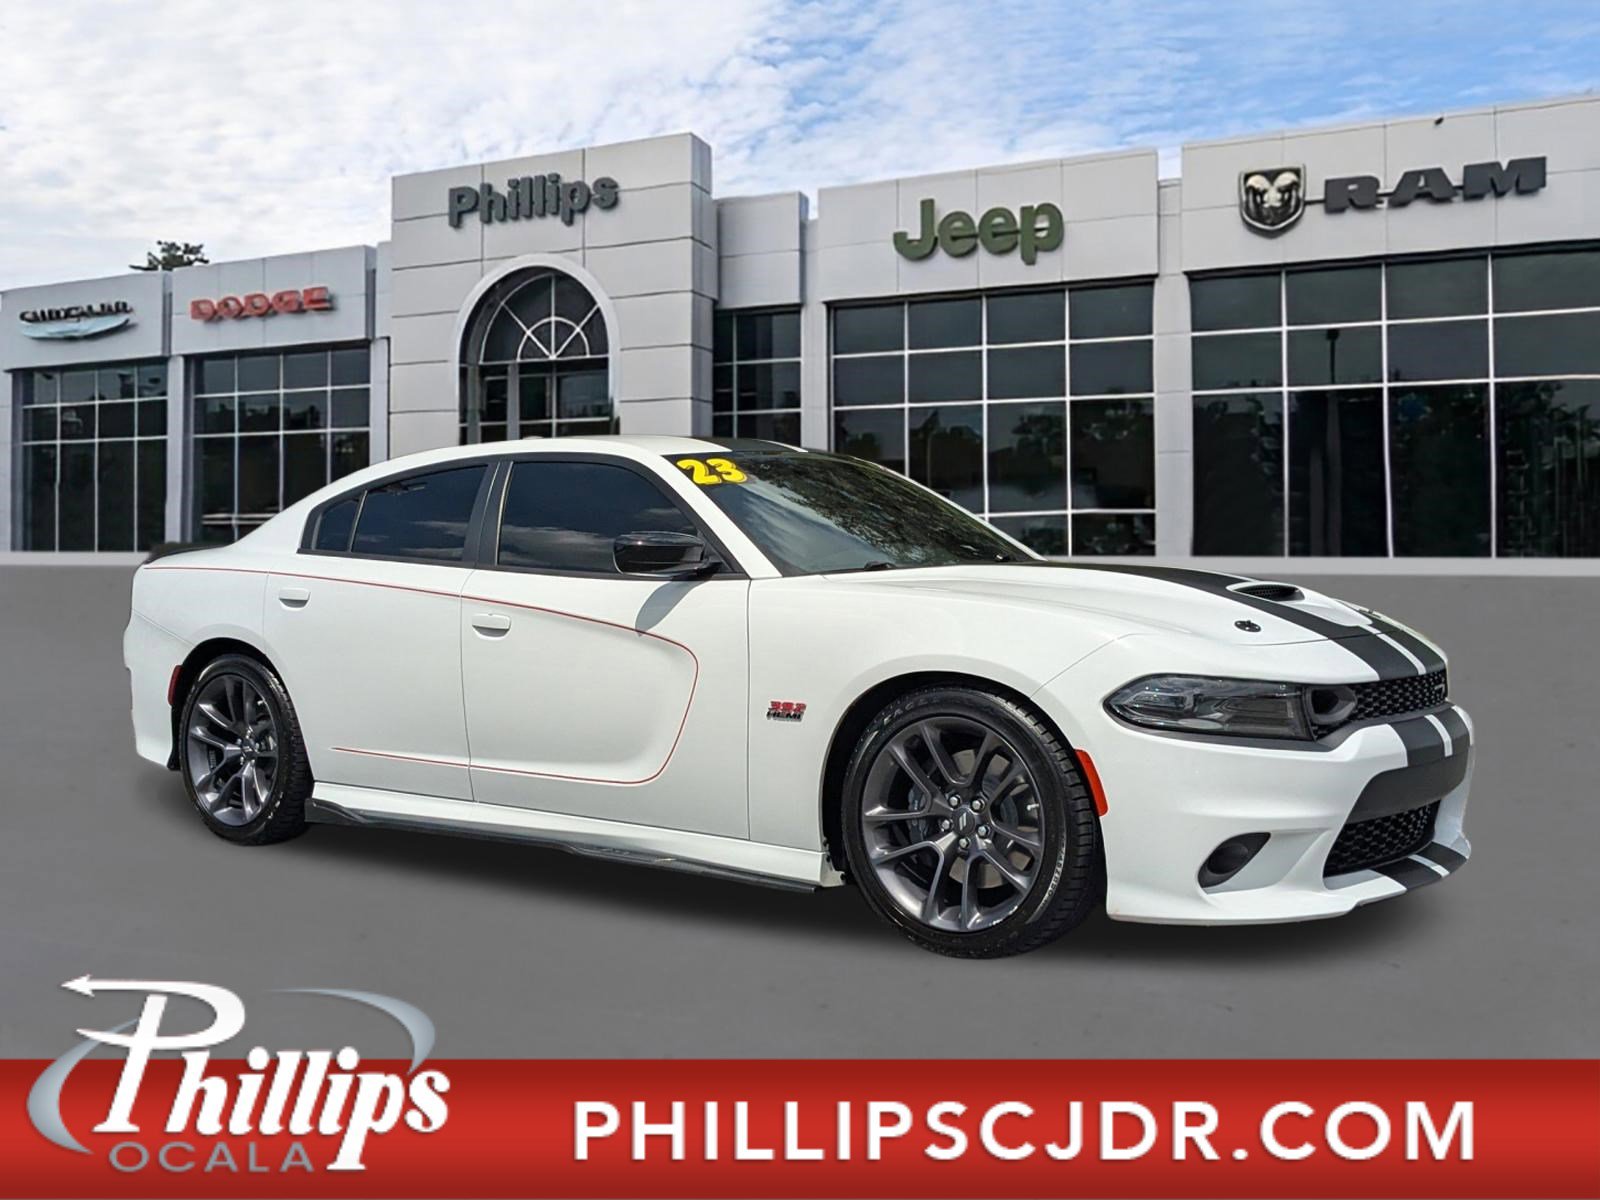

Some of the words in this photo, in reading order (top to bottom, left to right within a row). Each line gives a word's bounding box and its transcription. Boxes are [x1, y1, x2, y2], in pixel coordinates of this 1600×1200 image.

[448, 173, 620, 228] Phillips
[1324, 156, 1547, 214] RAM
[893, 198, 1064, 266] Jeep
[190, 286, 334, 322] DODGE
[676, 458, 748, 485] 23
